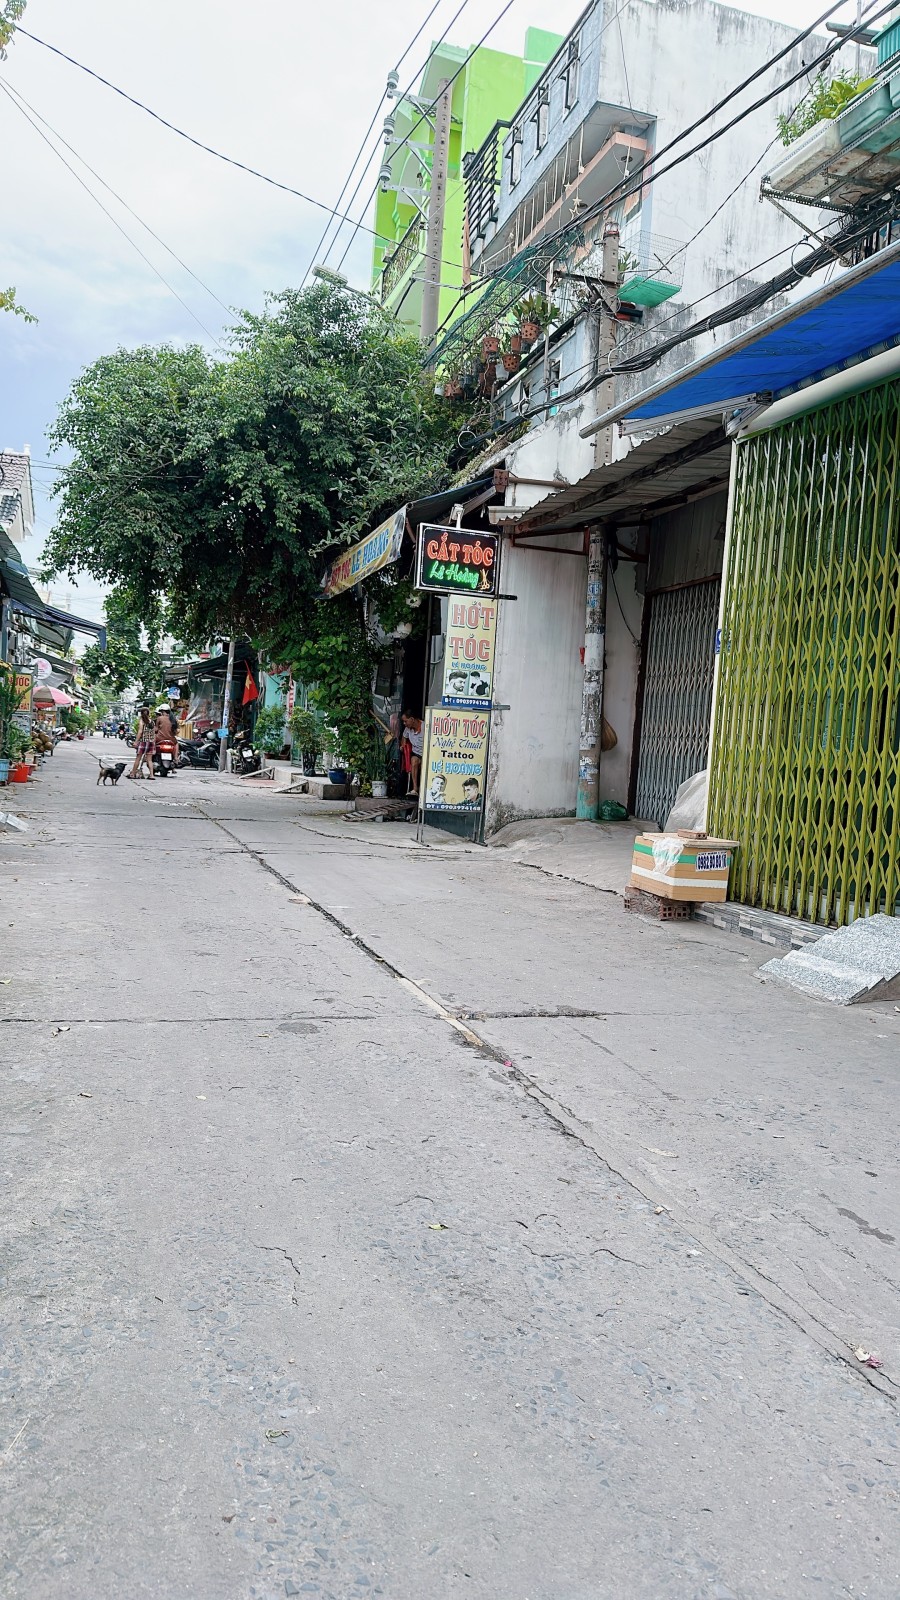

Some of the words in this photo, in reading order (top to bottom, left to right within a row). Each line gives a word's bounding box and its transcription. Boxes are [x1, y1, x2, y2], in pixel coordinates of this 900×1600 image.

[427, 532, 460, 562] CẮT
[463, 541, 494, 566] TÓC
[451, 601, 495, 630] HỚT
[449, 633, 491, 661] TÓC
[432, 712, 461, 737] HỚT
[462, 714, 487, 739] TÓC
[432, 737, 457, 750] Nghệ
[458, 738, 483, 751] Thuật
[441, 750, 474, 760] Tattoo
